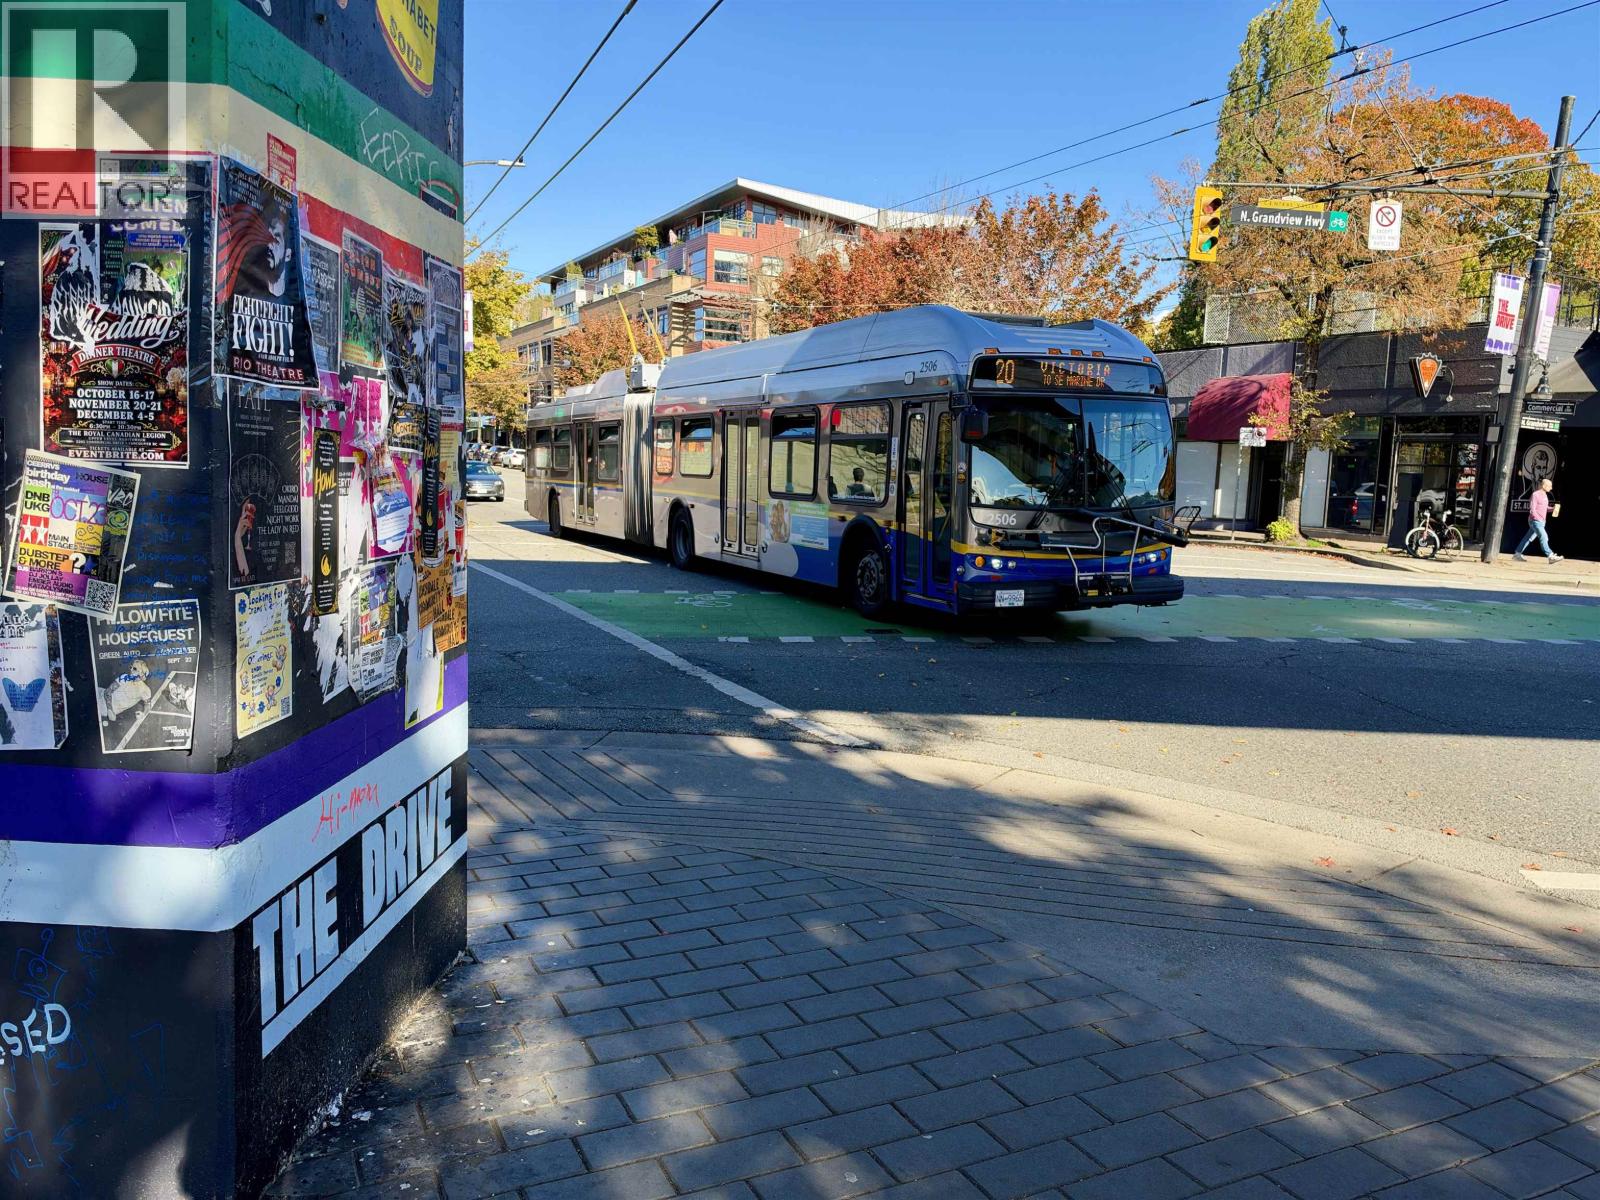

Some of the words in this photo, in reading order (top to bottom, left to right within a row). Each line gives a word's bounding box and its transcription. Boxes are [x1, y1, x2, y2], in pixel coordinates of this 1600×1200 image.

[389, 15, 423, 74] SOUP
[1240, 210, 1251, 222] N.
[1252, 211, 1303, 226] Grandview
[1305, 214, 1326, 230] Hwy
[1498, 298, 1509, 312] THE
[1495, 314, 1515, 330] DRIVE
[232, 313, 295, 357] FIGHT!
[116, 346, 156, 364] THEATRE
[233, 357, 251, 370] RIO
[256, 361, 304, 380] THEATRE
[920, 361, 938, 373] 2506
[995, 359, 1015, 384] 20
[1040, 361, 1111, 377] VICTORIA
[1043, 374, 1051, 385] TO
[1054, 374, 1064, 386] SE
[1096, 377, 1106, 388] DR
[77, 388, 125, 399] OCTOBER
[129, 390, 154, 400] 16-17
[69, 398, 130, 409] NOVEMBER
[133, 401, 162, 411] 20-21
[77, 409, 134, 420] DECEMBER
[137, 412, 154, 420] 4-5
[68, 449, 164, 460] EVENTBRITE.COM
[25, 467, 70, 484] birthday
[25, 478, 51, 489] bash
[314, 467, 337, 500] HOWL
[25, 490, 50, 502] DNB
[25, 501, 50, 512] UKG
[987, 513, 1017, 526] 2506
[48, 533, 69, 542] MAIN
[19, 547, 69, 562] DUBSTEP
[28, 558, 62, 570] MORE
[98, 627, 195, 646] HOUSEGUEST
[98, 651, 120, 659] GREEN
[362, 767, 452, 929] DRIVE
[252, 855, 339, 1025] THE
